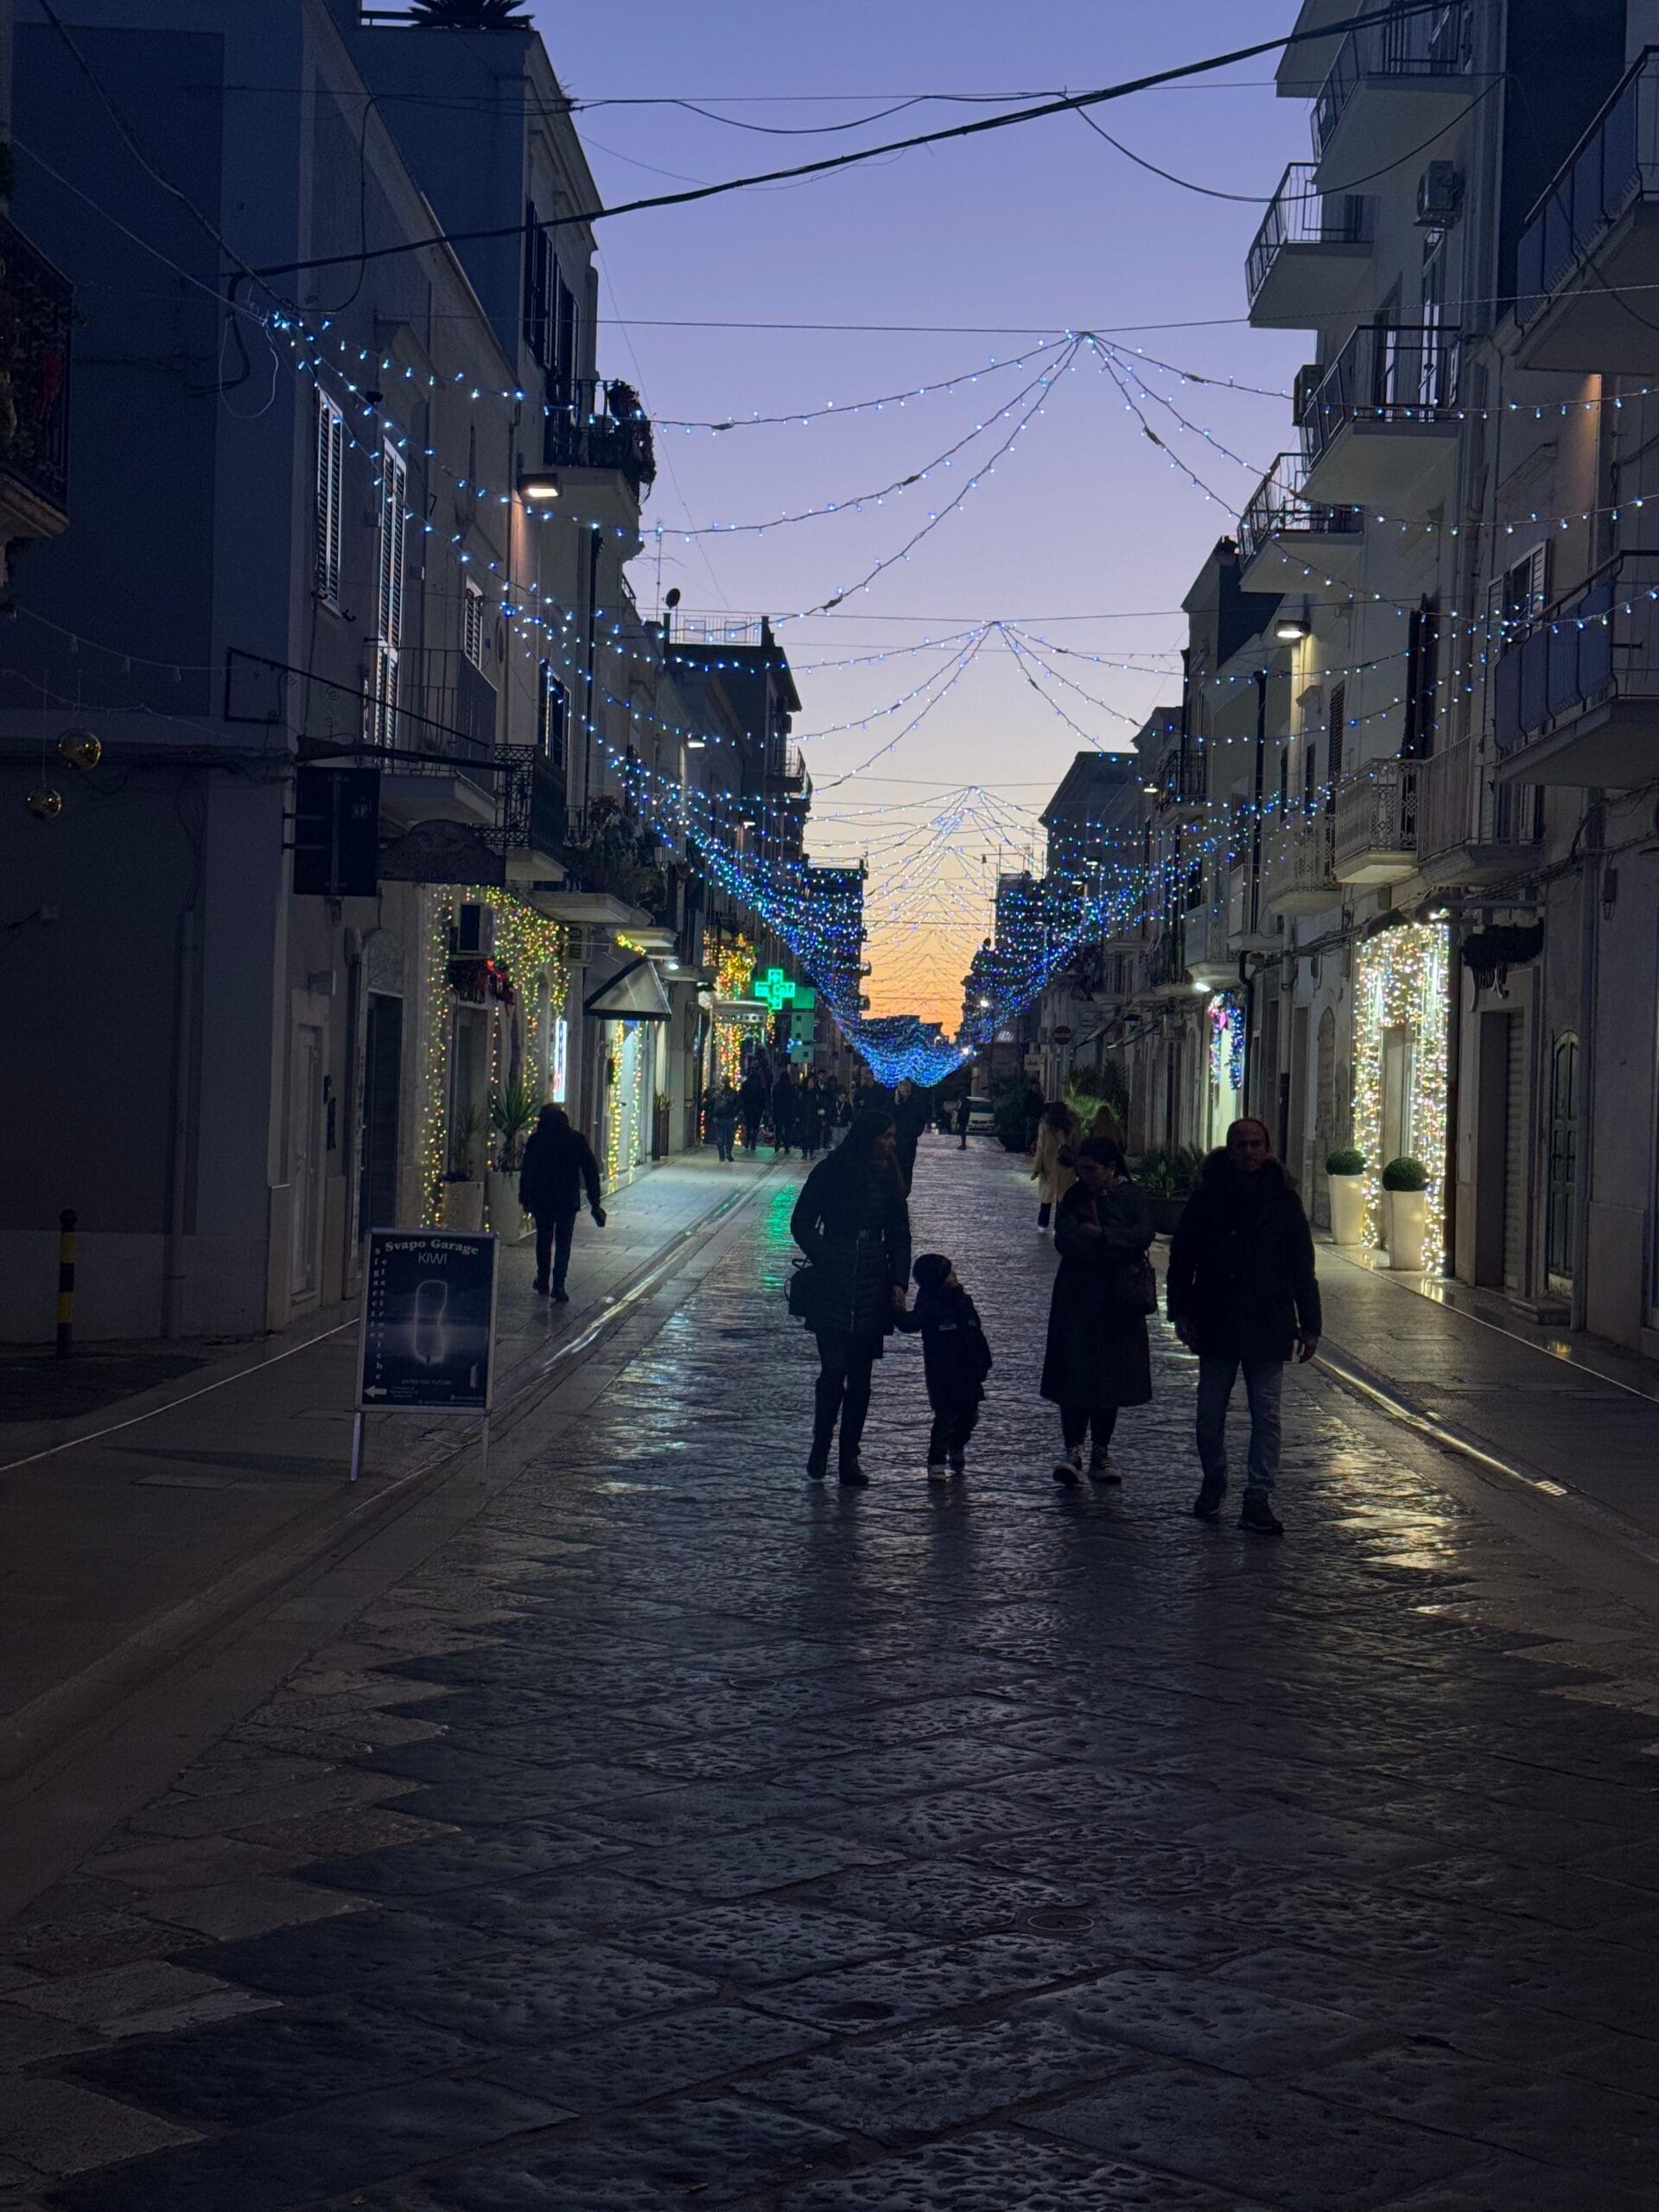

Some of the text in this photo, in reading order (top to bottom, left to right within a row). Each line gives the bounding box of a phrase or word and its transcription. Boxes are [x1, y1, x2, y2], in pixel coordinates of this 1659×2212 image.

[385, 1238, 480, 1255] Svapo Garage
[418, 1252, 448, 1265] KIWI
